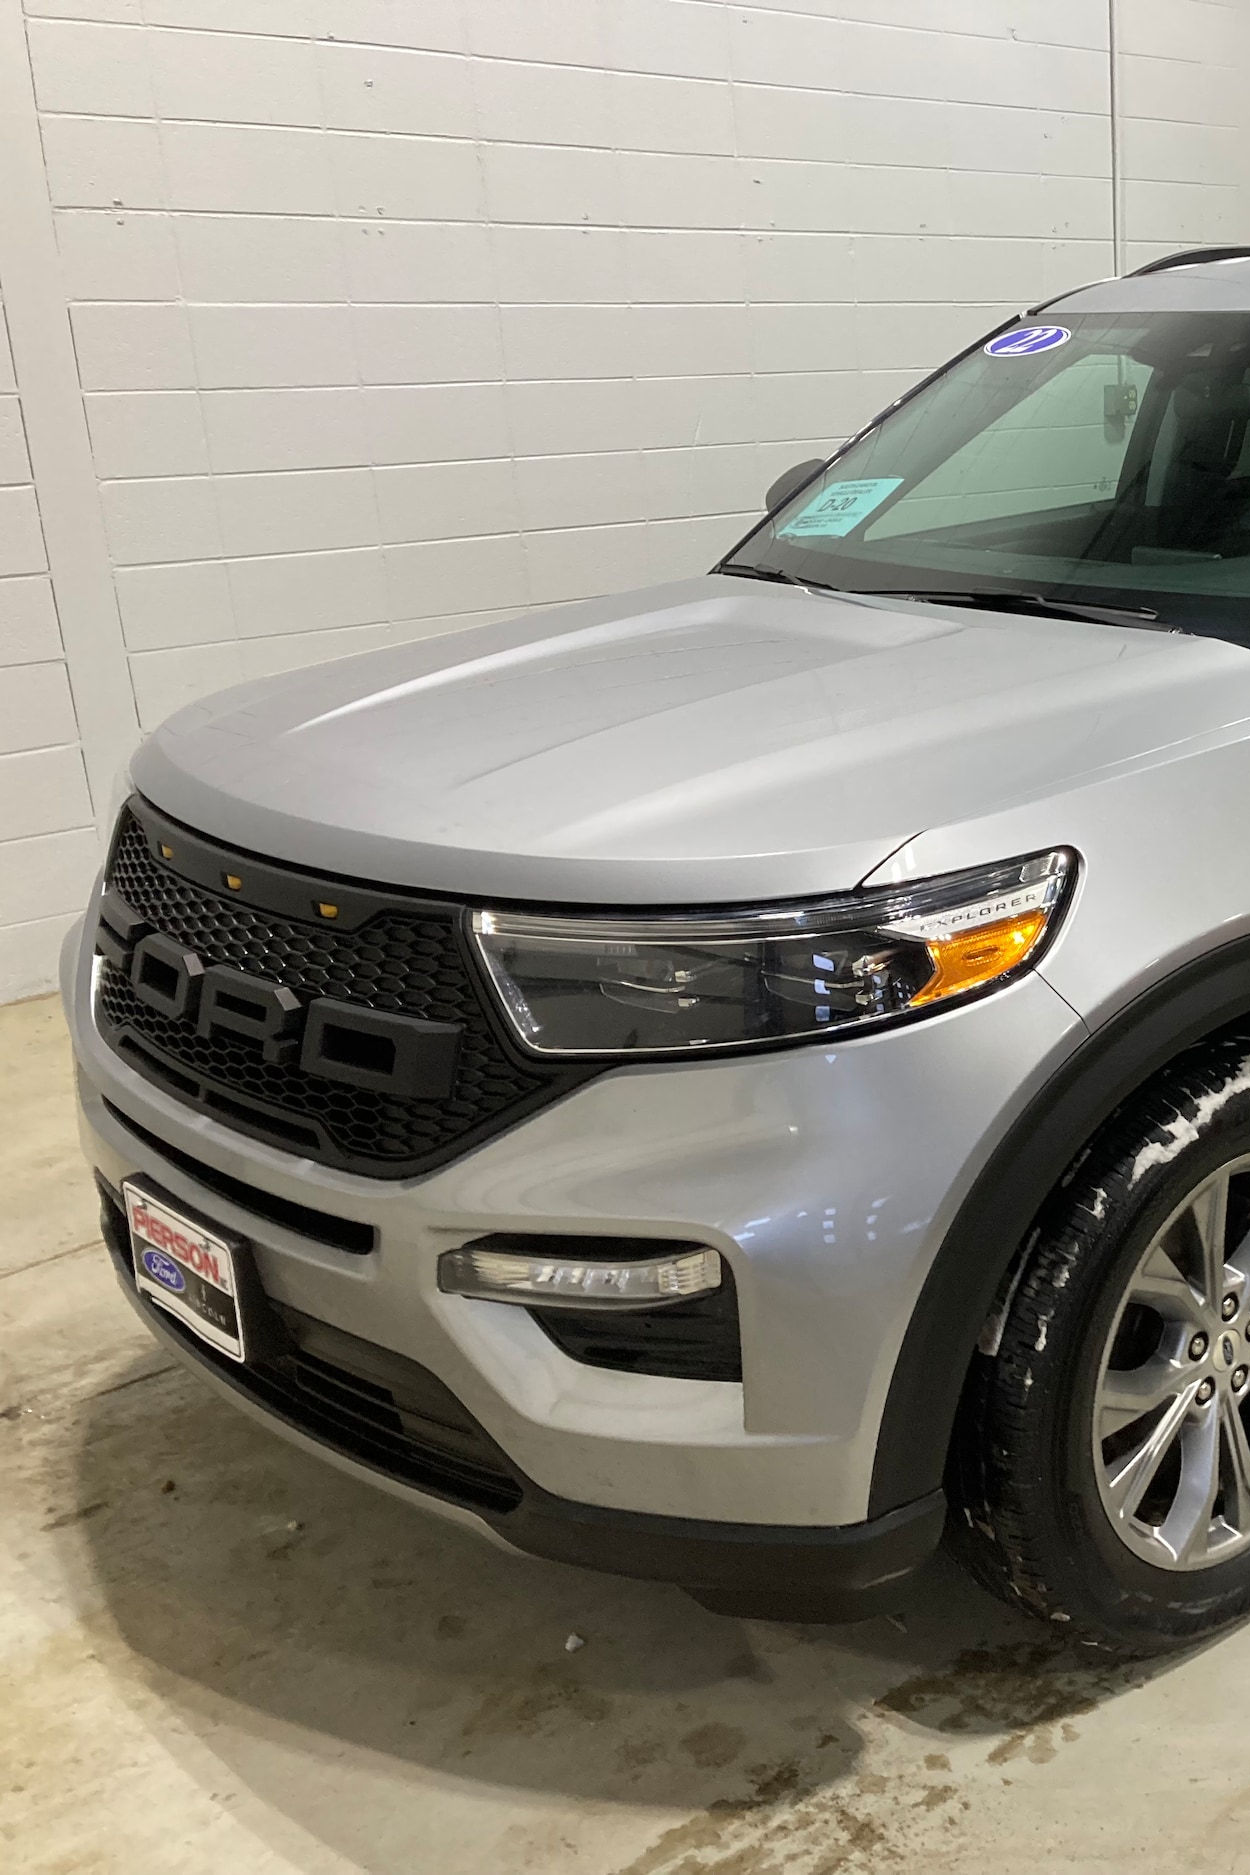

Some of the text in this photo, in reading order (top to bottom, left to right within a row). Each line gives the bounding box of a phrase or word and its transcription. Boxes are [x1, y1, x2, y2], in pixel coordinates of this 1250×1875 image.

[817, 497, 858, 512] D-20
[919, 892, 1037, 932] EXPLORER
[132, 1205, 220, 1284] PIERSON
[151, 1254, 179, 1288] Ford
